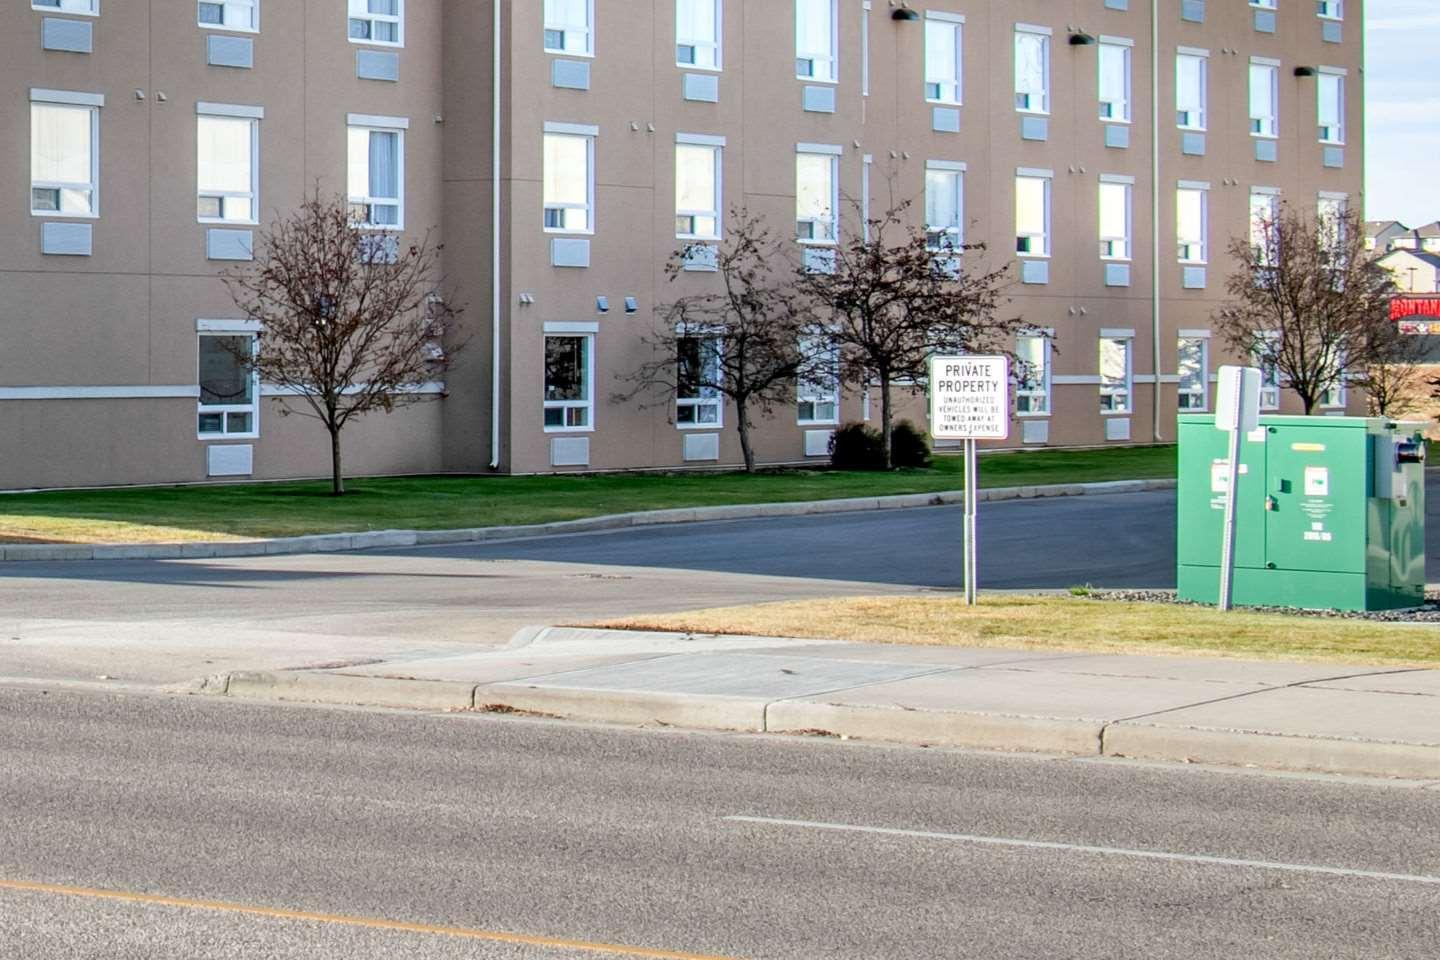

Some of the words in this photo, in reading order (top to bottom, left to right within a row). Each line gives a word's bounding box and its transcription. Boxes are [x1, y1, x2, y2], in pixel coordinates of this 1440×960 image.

[945, 365, 991, 377] PRIVATE
[938, 380, 999, 393] PROPERTY
[943, 396, 995, 404] UNAUTHORIZED
[939, 406, 971, 414] VEHICLES
[943, 414, 966, 422] TOWED
